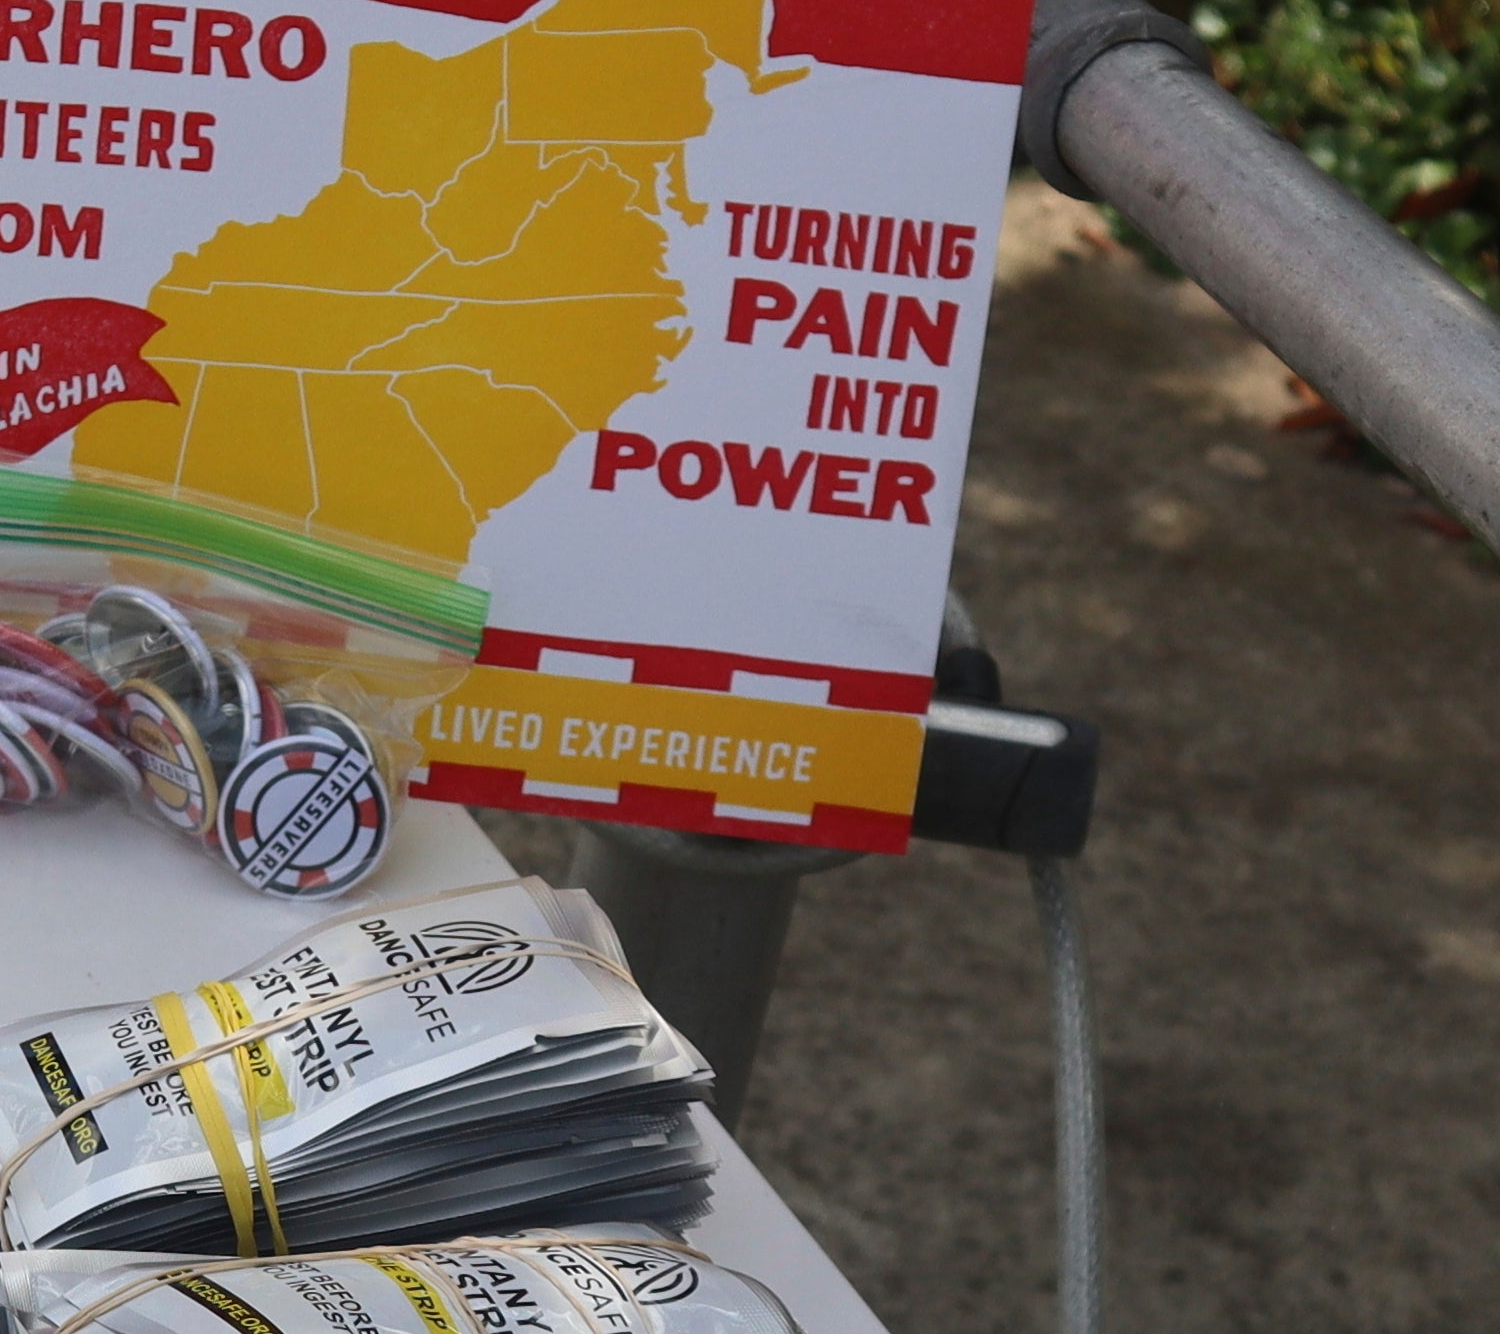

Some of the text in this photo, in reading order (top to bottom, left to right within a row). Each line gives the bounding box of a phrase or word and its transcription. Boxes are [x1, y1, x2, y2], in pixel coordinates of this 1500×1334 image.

[724, 202, 976, 282] TURNING
[726, 277, 960, 368] PAIN
[807, 373, 939, 441] INTO
[590, 428, 939, 527] POWER
[430, 703, 818, 784] LIVED EXPERIENCE
[108, 1019, 139, 1049] YOU
[147, 1037, 195, 1117] BEORE
[263, 1265, 298, 1280] OU
[396, 1274, 449, 1332] STRIP
